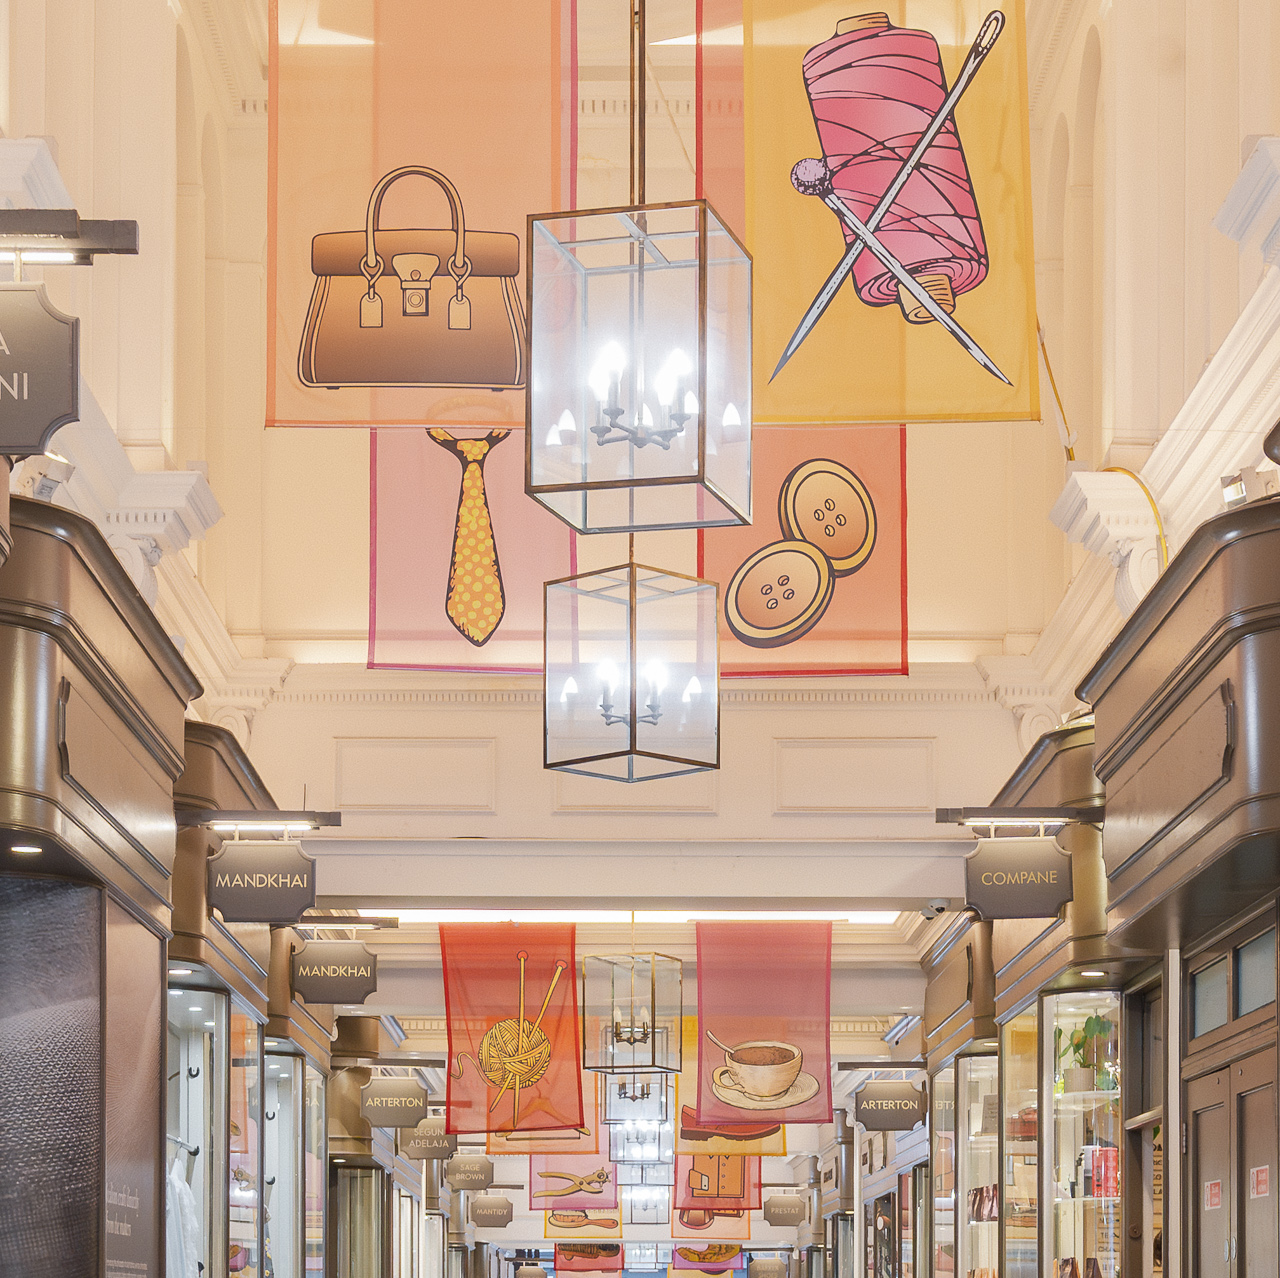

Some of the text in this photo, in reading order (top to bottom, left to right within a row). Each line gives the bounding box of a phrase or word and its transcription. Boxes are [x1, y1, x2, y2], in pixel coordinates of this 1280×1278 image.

[215, 873, 307, 889] MANDKHAI
[981, 870, 1057, 886] COMPANE
[298, 965, 371, 978] MANDKHAI
[365, 1097, 423, 1108] ARTERTON
[860, 1100, 918, 1110] ARTERTON
[414, 1128, 444, 1136] SEGUN
[409, 1140, 450, 1148] ADELAJA
[476, 1208, 508, 1216] MANTIDY
